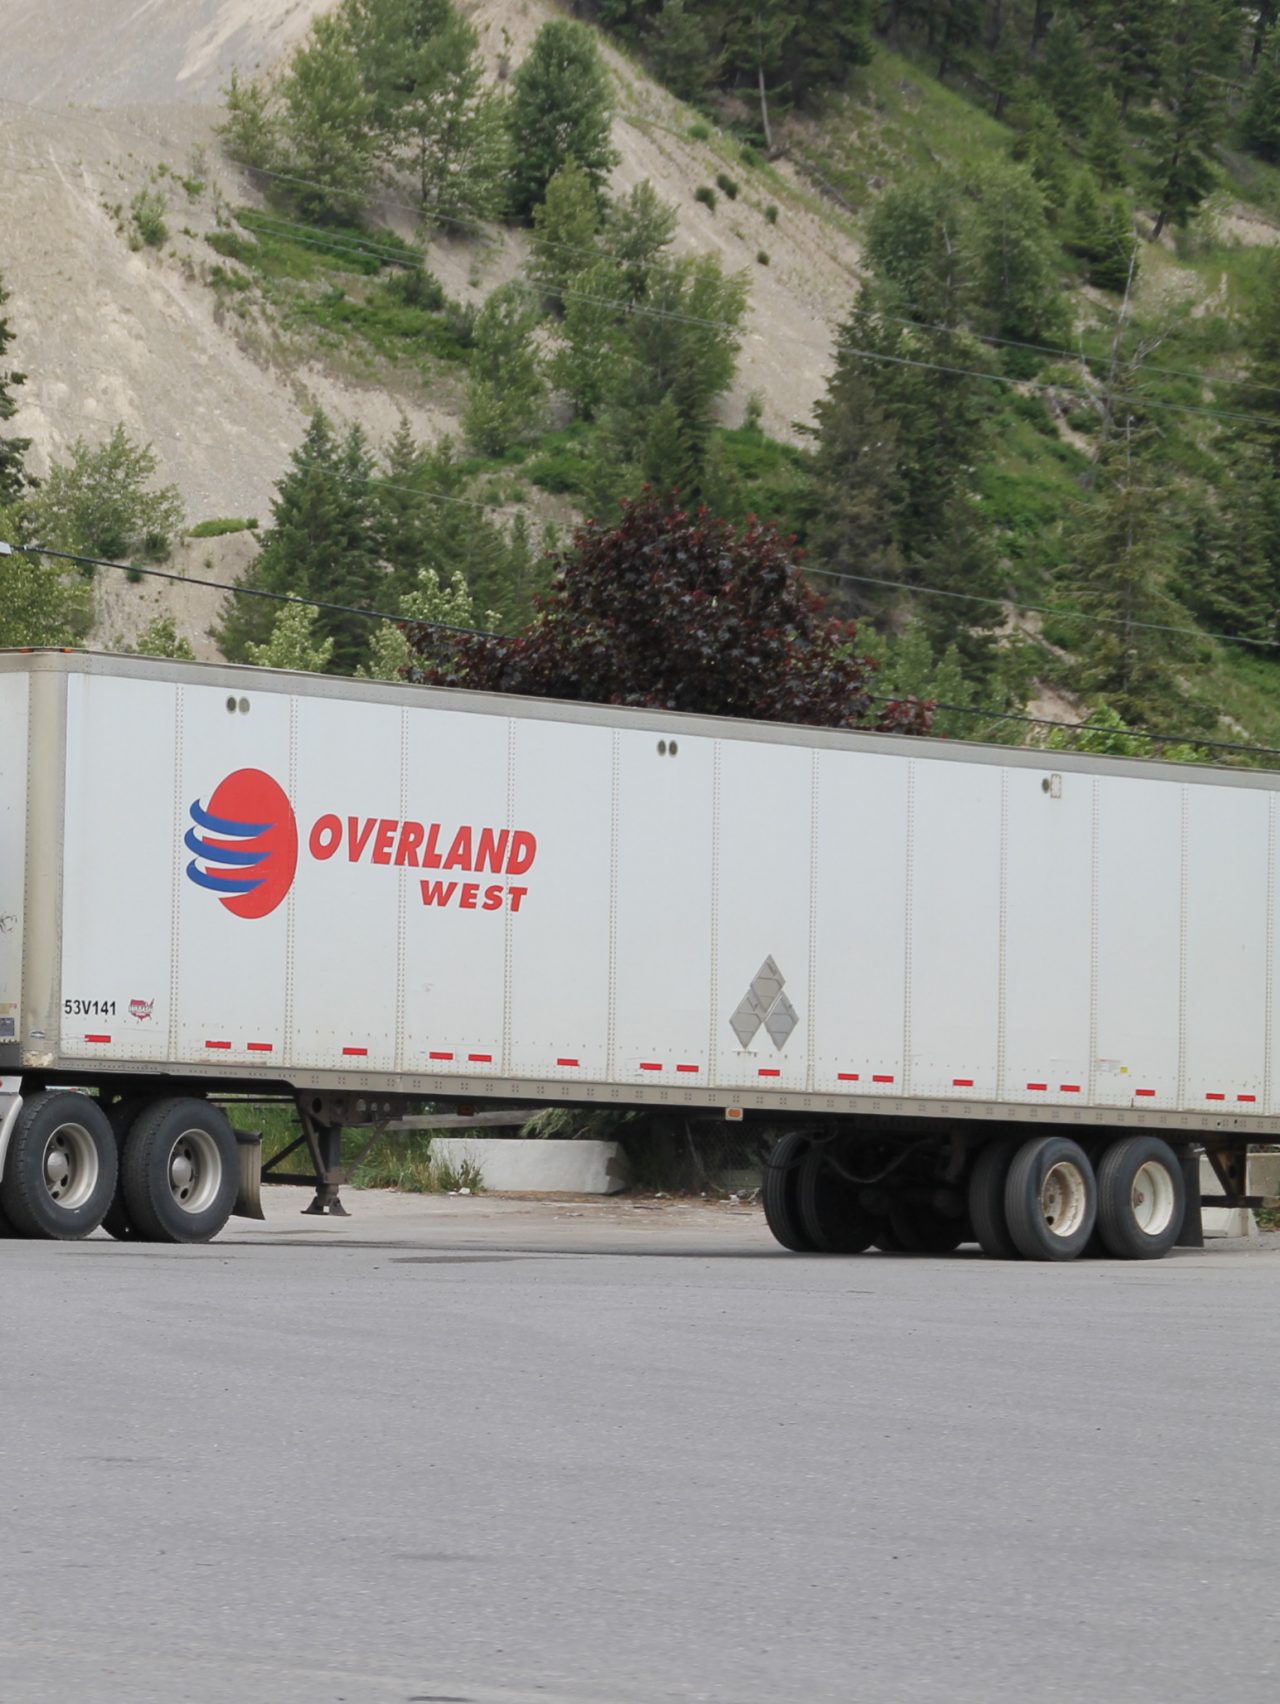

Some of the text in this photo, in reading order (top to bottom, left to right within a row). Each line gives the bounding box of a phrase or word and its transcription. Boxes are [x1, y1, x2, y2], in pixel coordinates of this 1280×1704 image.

[309, 813, 537, 876] OVERLAND
[419, 879, 528, 912] WEST
[64, 999, 116, 1015] 53V141
